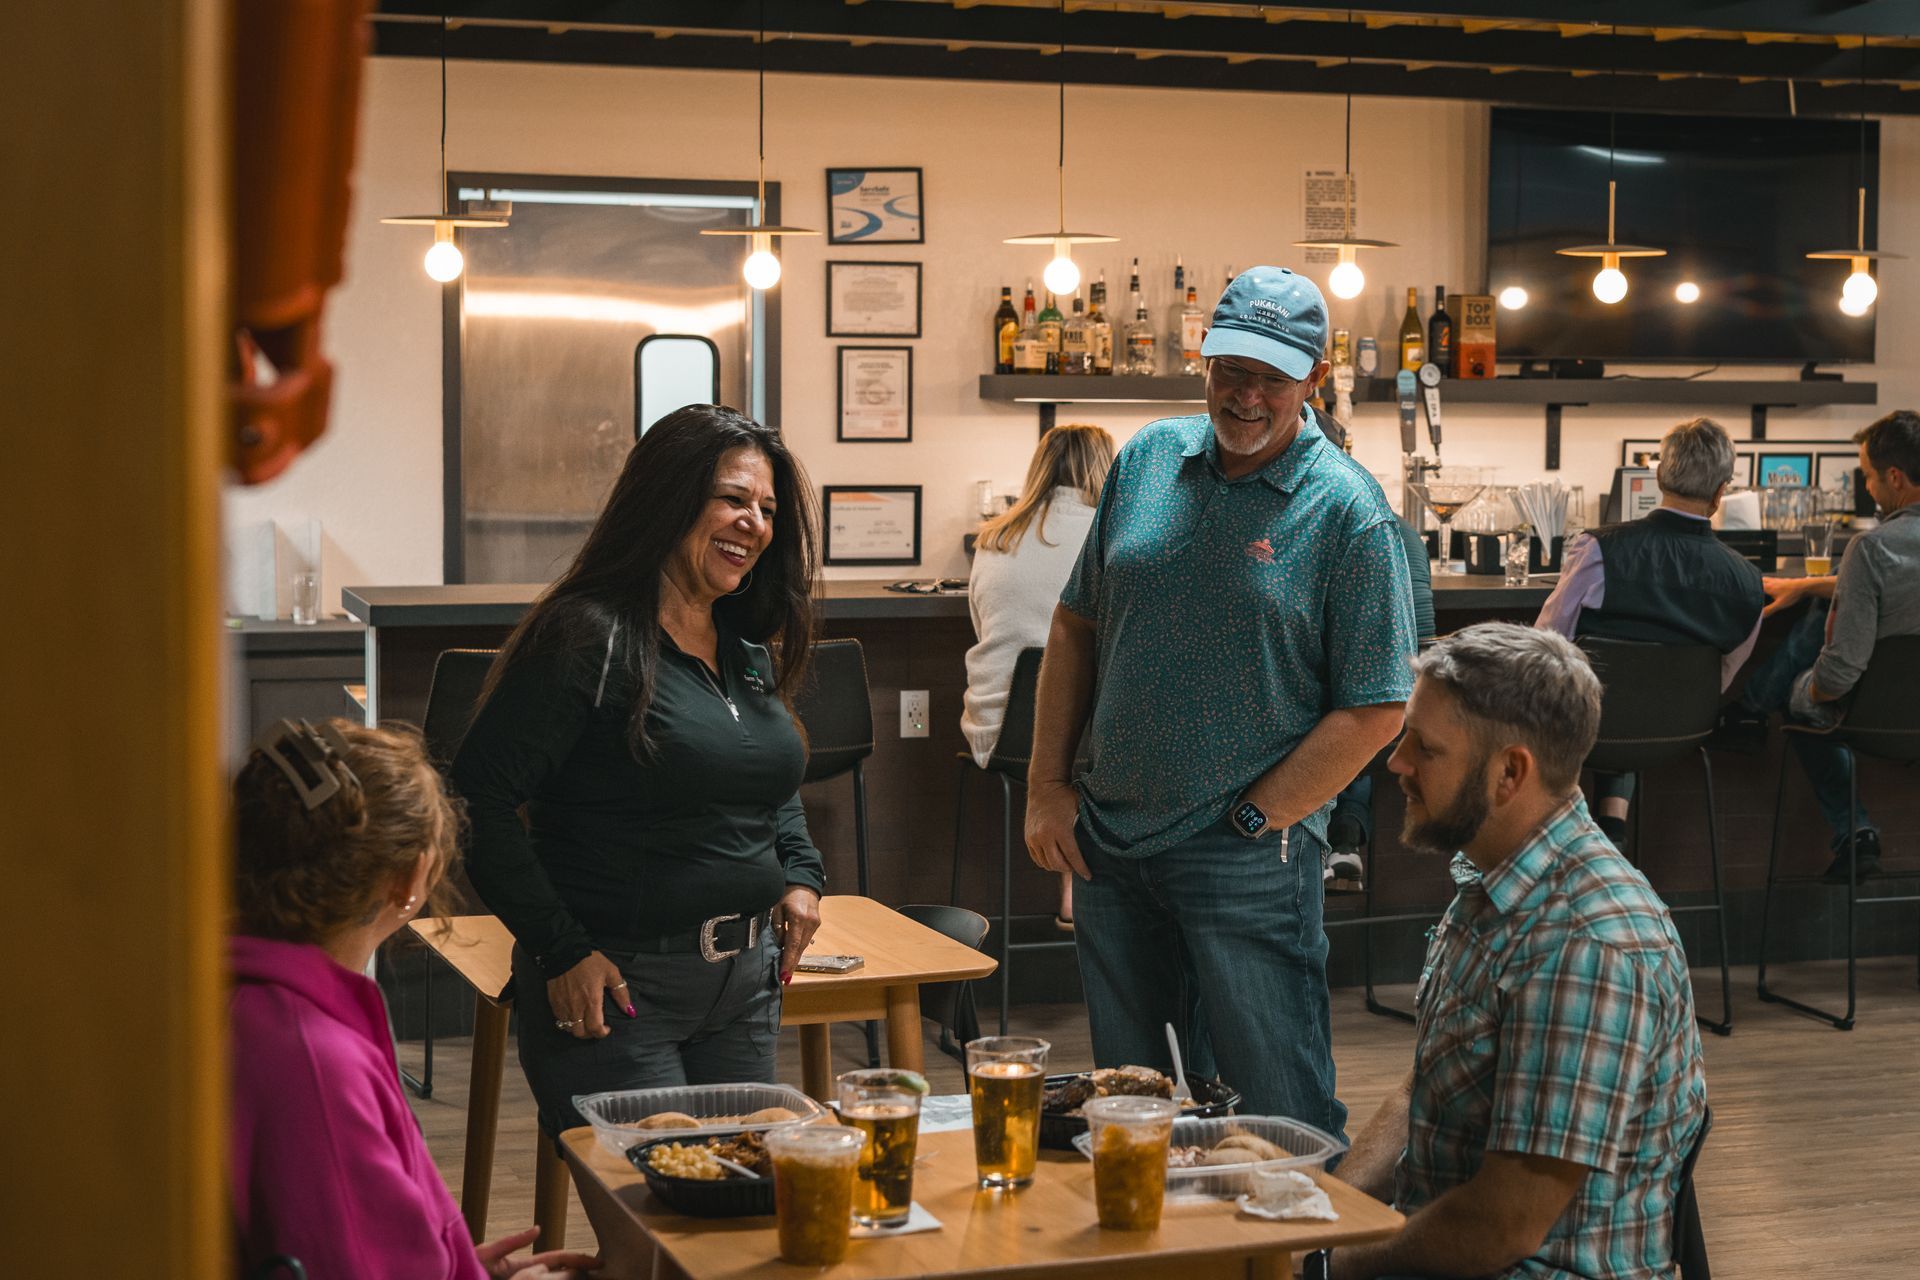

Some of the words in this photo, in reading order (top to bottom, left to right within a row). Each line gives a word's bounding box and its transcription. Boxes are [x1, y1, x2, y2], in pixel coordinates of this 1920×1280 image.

[1249, 299, 1290, 318] PUKALANI
[1466, 303, 1491, 314] TOP
[1240, 314, 1271, 324] COUNTRY
[1272, 321, 1290, 333] CLUB
[1466, 315, 1491, 325] BOX
